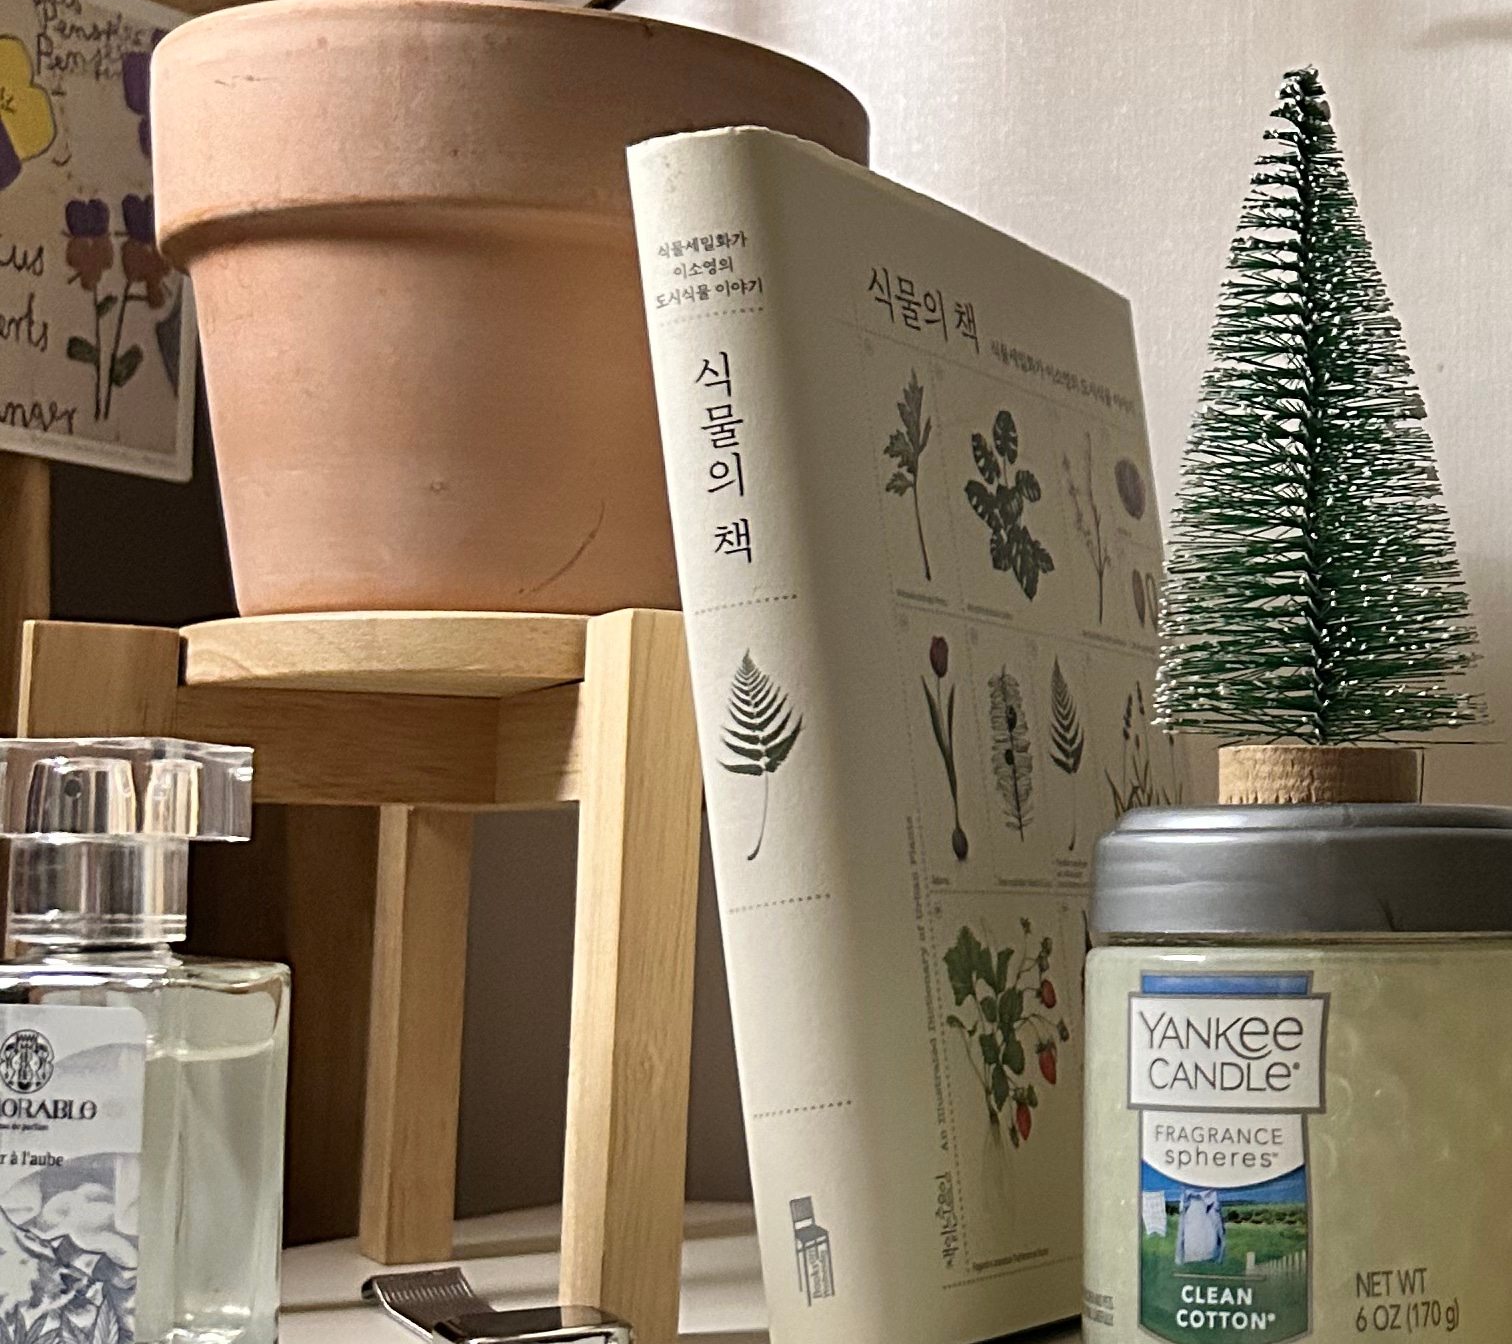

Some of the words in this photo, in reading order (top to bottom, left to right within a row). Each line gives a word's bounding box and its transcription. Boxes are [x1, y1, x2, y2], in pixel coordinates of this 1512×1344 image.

[658, 230, 748, 258] 식물세밀화가
[673, 256, 734, 278] 이소영의
[655, 284, 711, 309] 도시식물
[715, 277, 764, 297] 이야기
[867, 266, 949, 343] 식물의
[953, 301, 981, 355] 책
[695, 351, 744, 497] 식물의
[714, 518, 752, 564] 책
[1154, 1124, 1284, 1146] FRAGRANCE
[22, 1150, 64, 1167] l'aube
[1181, 1284, 1253, 1306] CLEAN
[1355, 1270, 1394, 1298] NET
[1397, 1267, 1428, 1296] WT
[1356, 1305, 1368, 1333] 6
[1373, 1304, 1402, 1332] OZ
[1407, 1300, 1442, 1334] (170
[1445, 1297, 1460, 1332] g)
